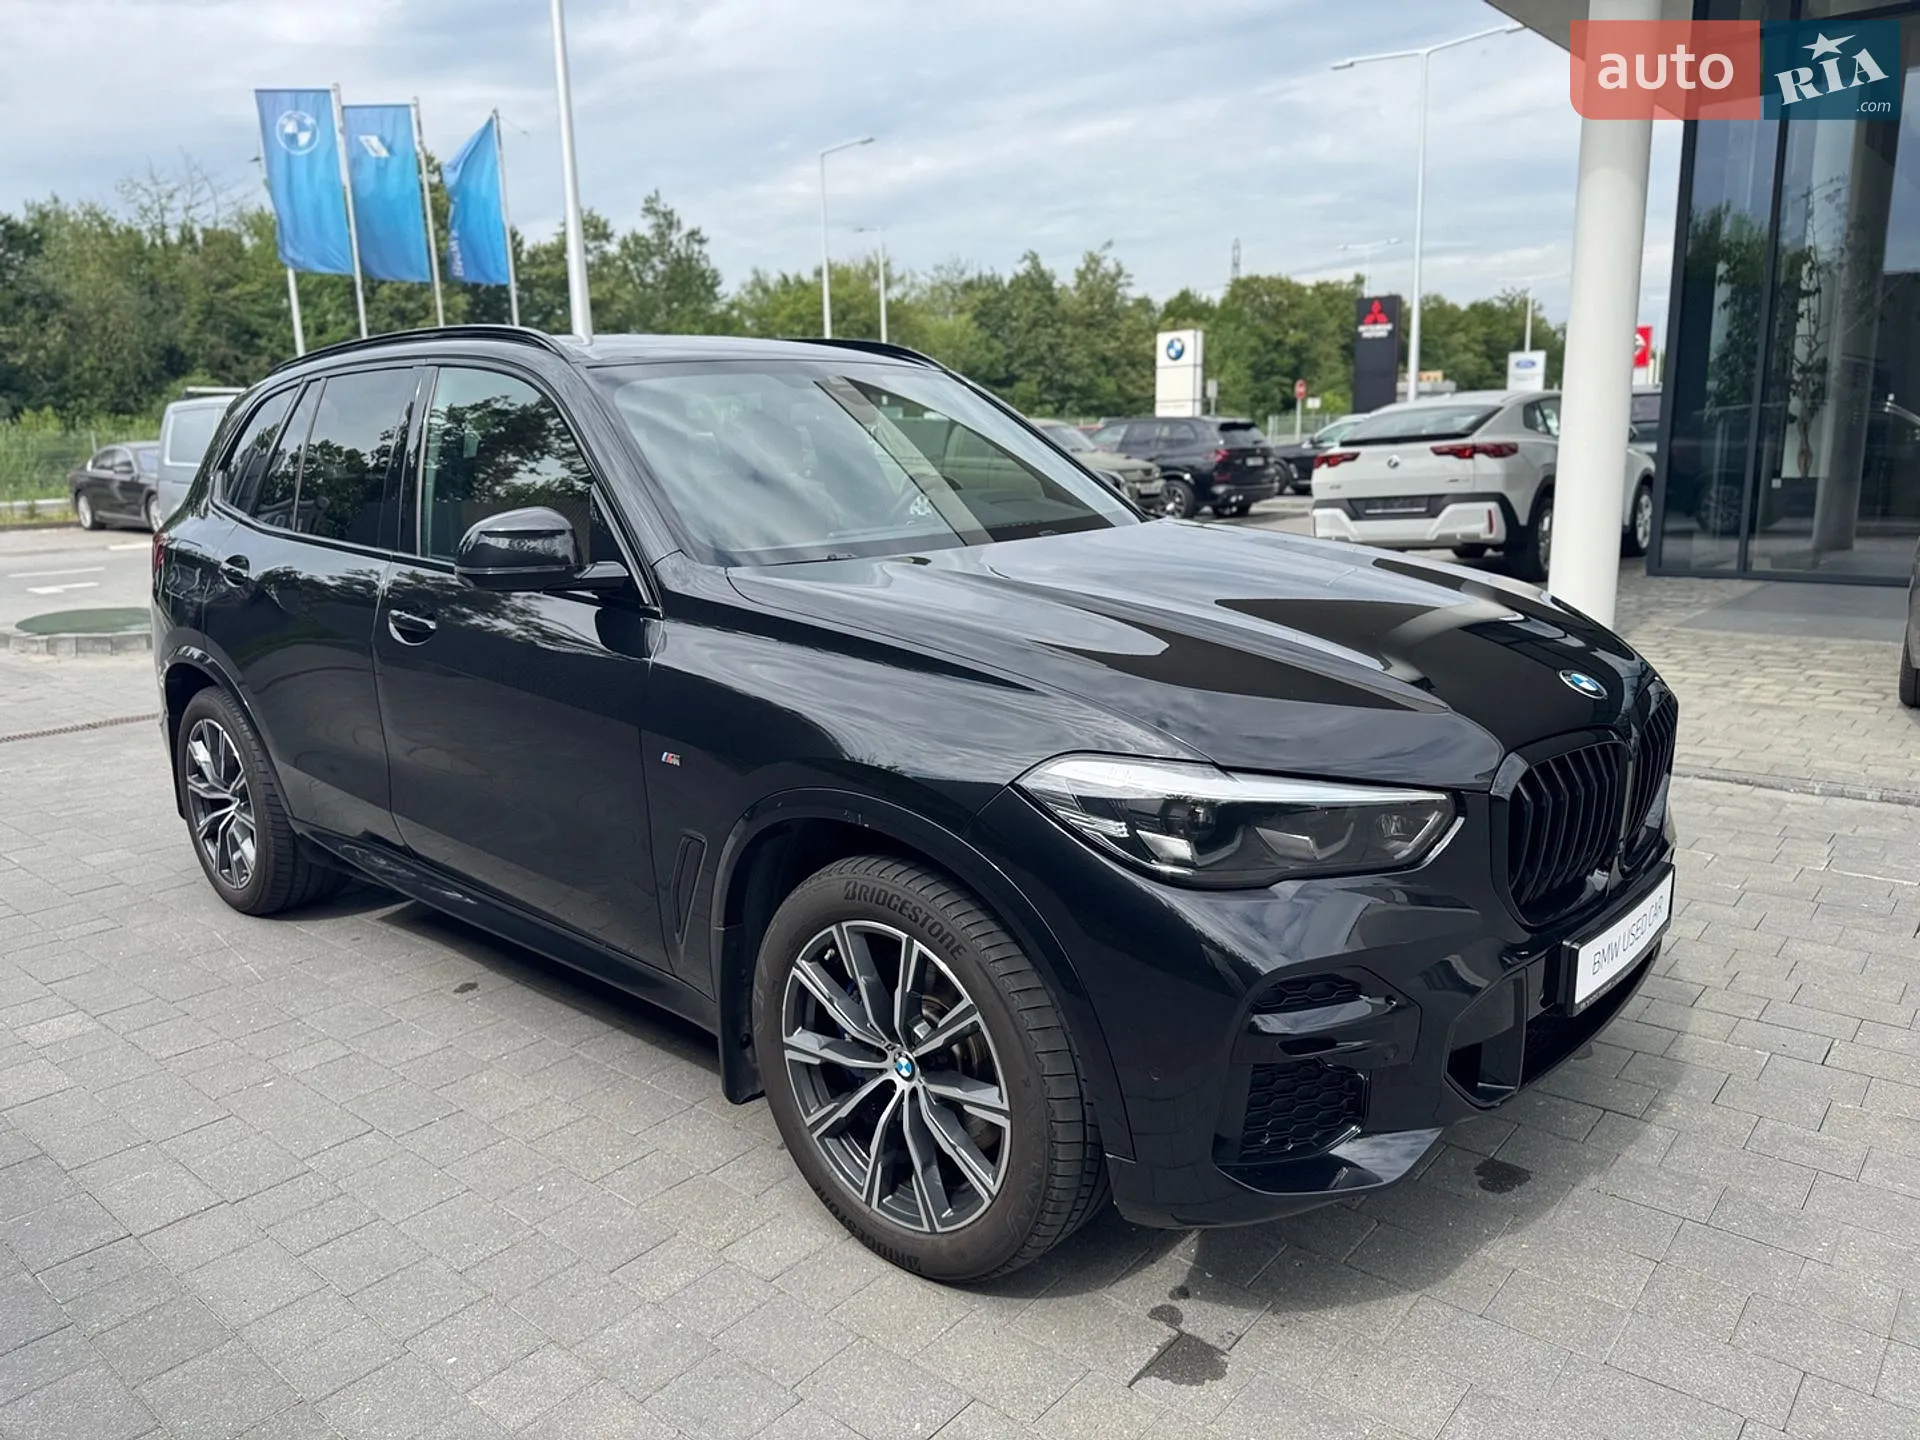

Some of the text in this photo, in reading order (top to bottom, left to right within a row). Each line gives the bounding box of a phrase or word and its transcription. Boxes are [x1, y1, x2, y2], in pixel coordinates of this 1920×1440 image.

[844, 880, 967, 961] BRIDGESTONE
[1592, 895, 1664, 976] BMW USED CAR
